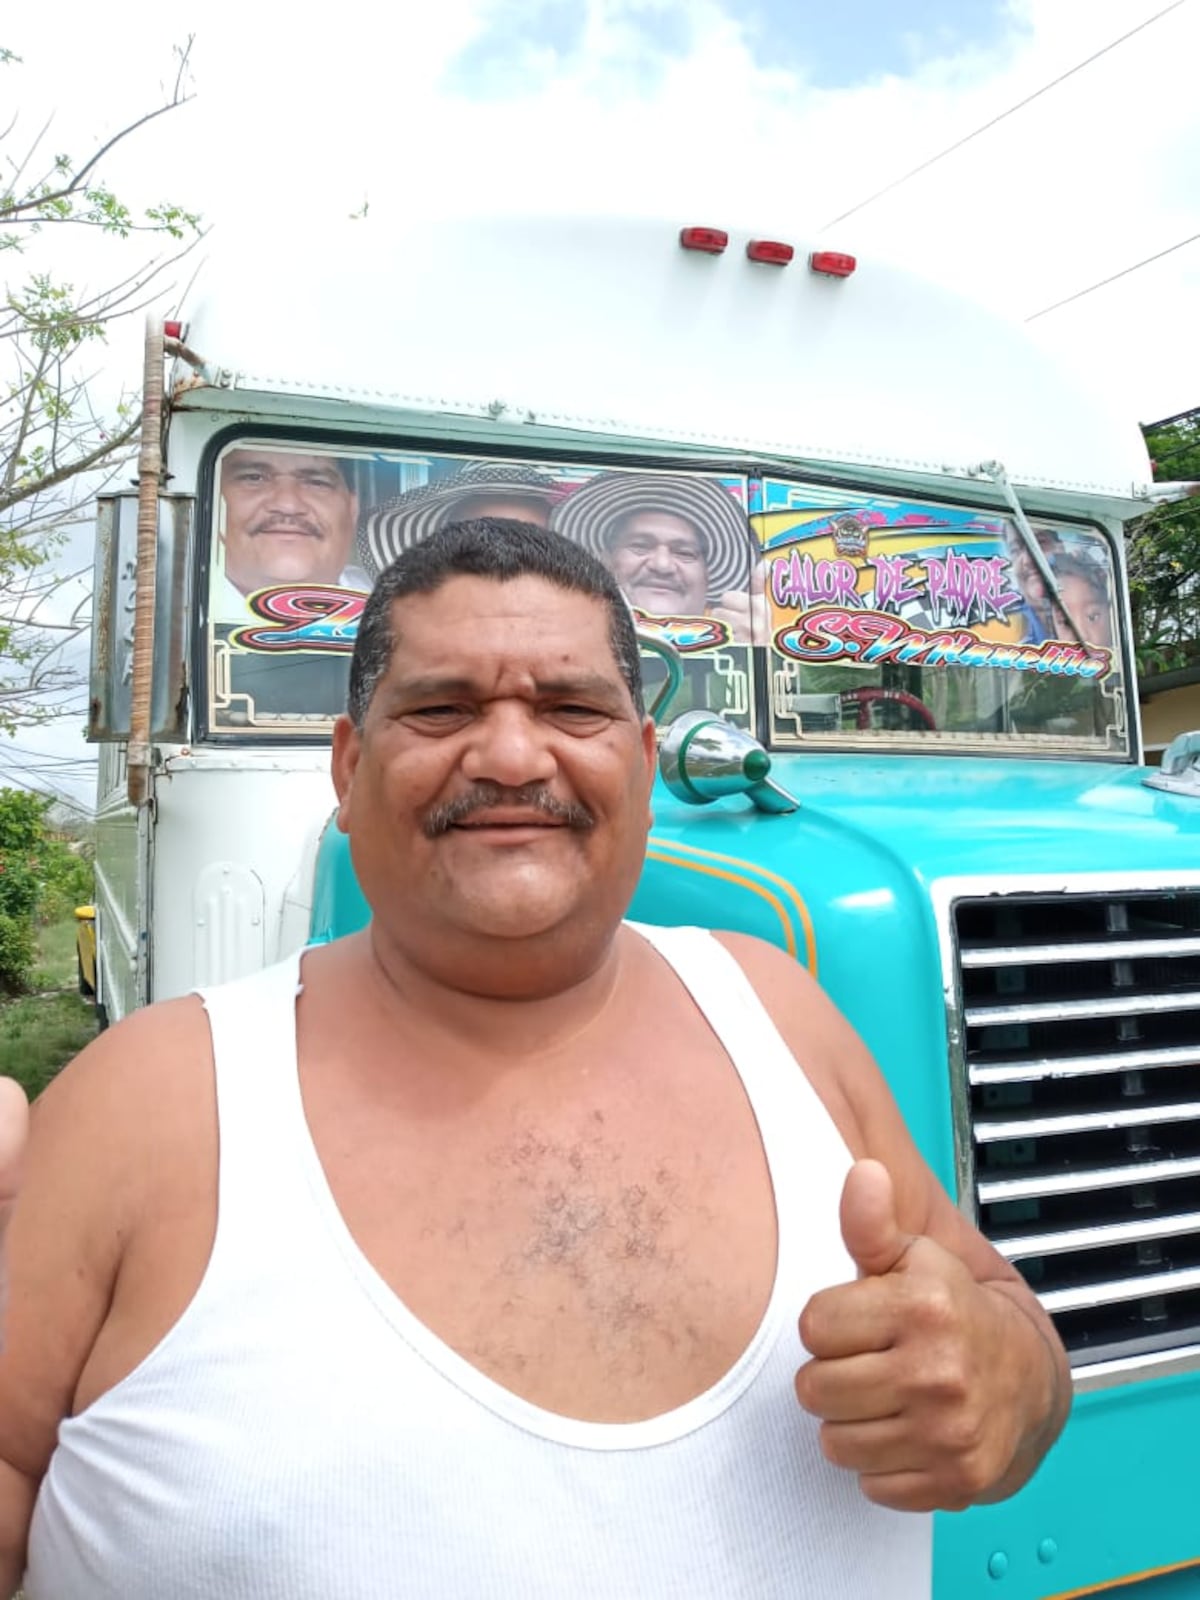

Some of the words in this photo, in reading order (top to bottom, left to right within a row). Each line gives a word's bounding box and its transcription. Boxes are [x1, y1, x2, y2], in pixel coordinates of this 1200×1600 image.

[772, 548, 862, 612] CALOR
[866, 553, 925, 614] DE
[921, 547, 1023, 624] PADRE
